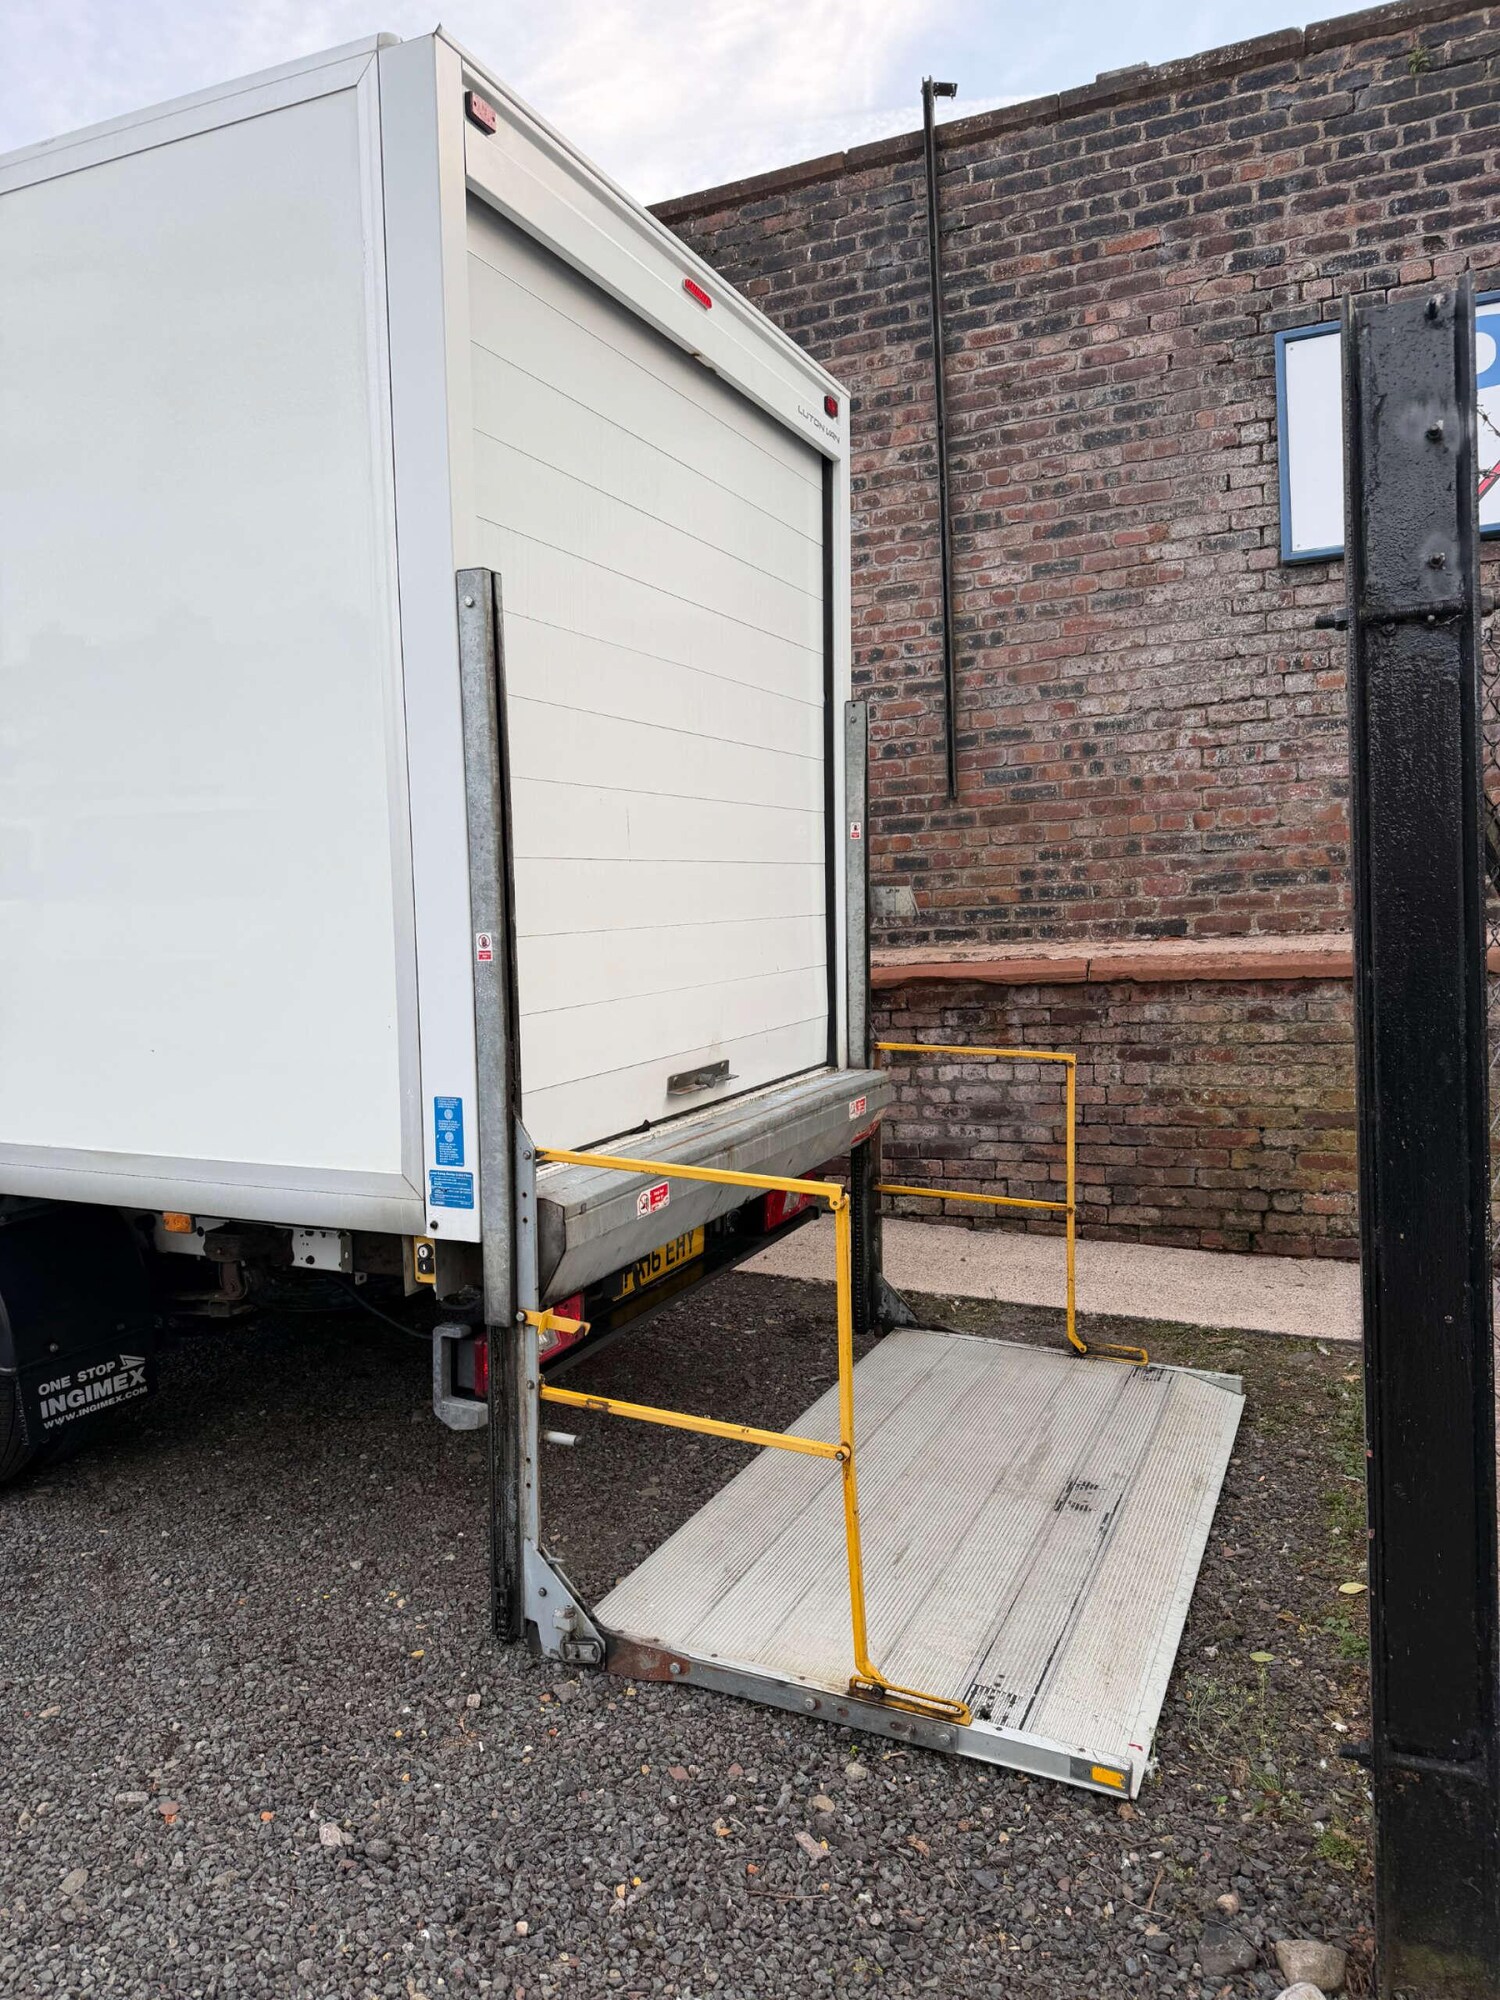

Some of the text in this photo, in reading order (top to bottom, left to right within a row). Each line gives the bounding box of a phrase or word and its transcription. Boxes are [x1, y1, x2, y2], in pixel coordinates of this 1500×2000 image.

[797, 404, 841, 444] LUTON VAN
[38, 1360, 116, 1396] ONE STOP
[39, 1366, 147, 1419] INGIMEX
[43, 1385, 149, 1429] WWW.INGIMEX.COM
